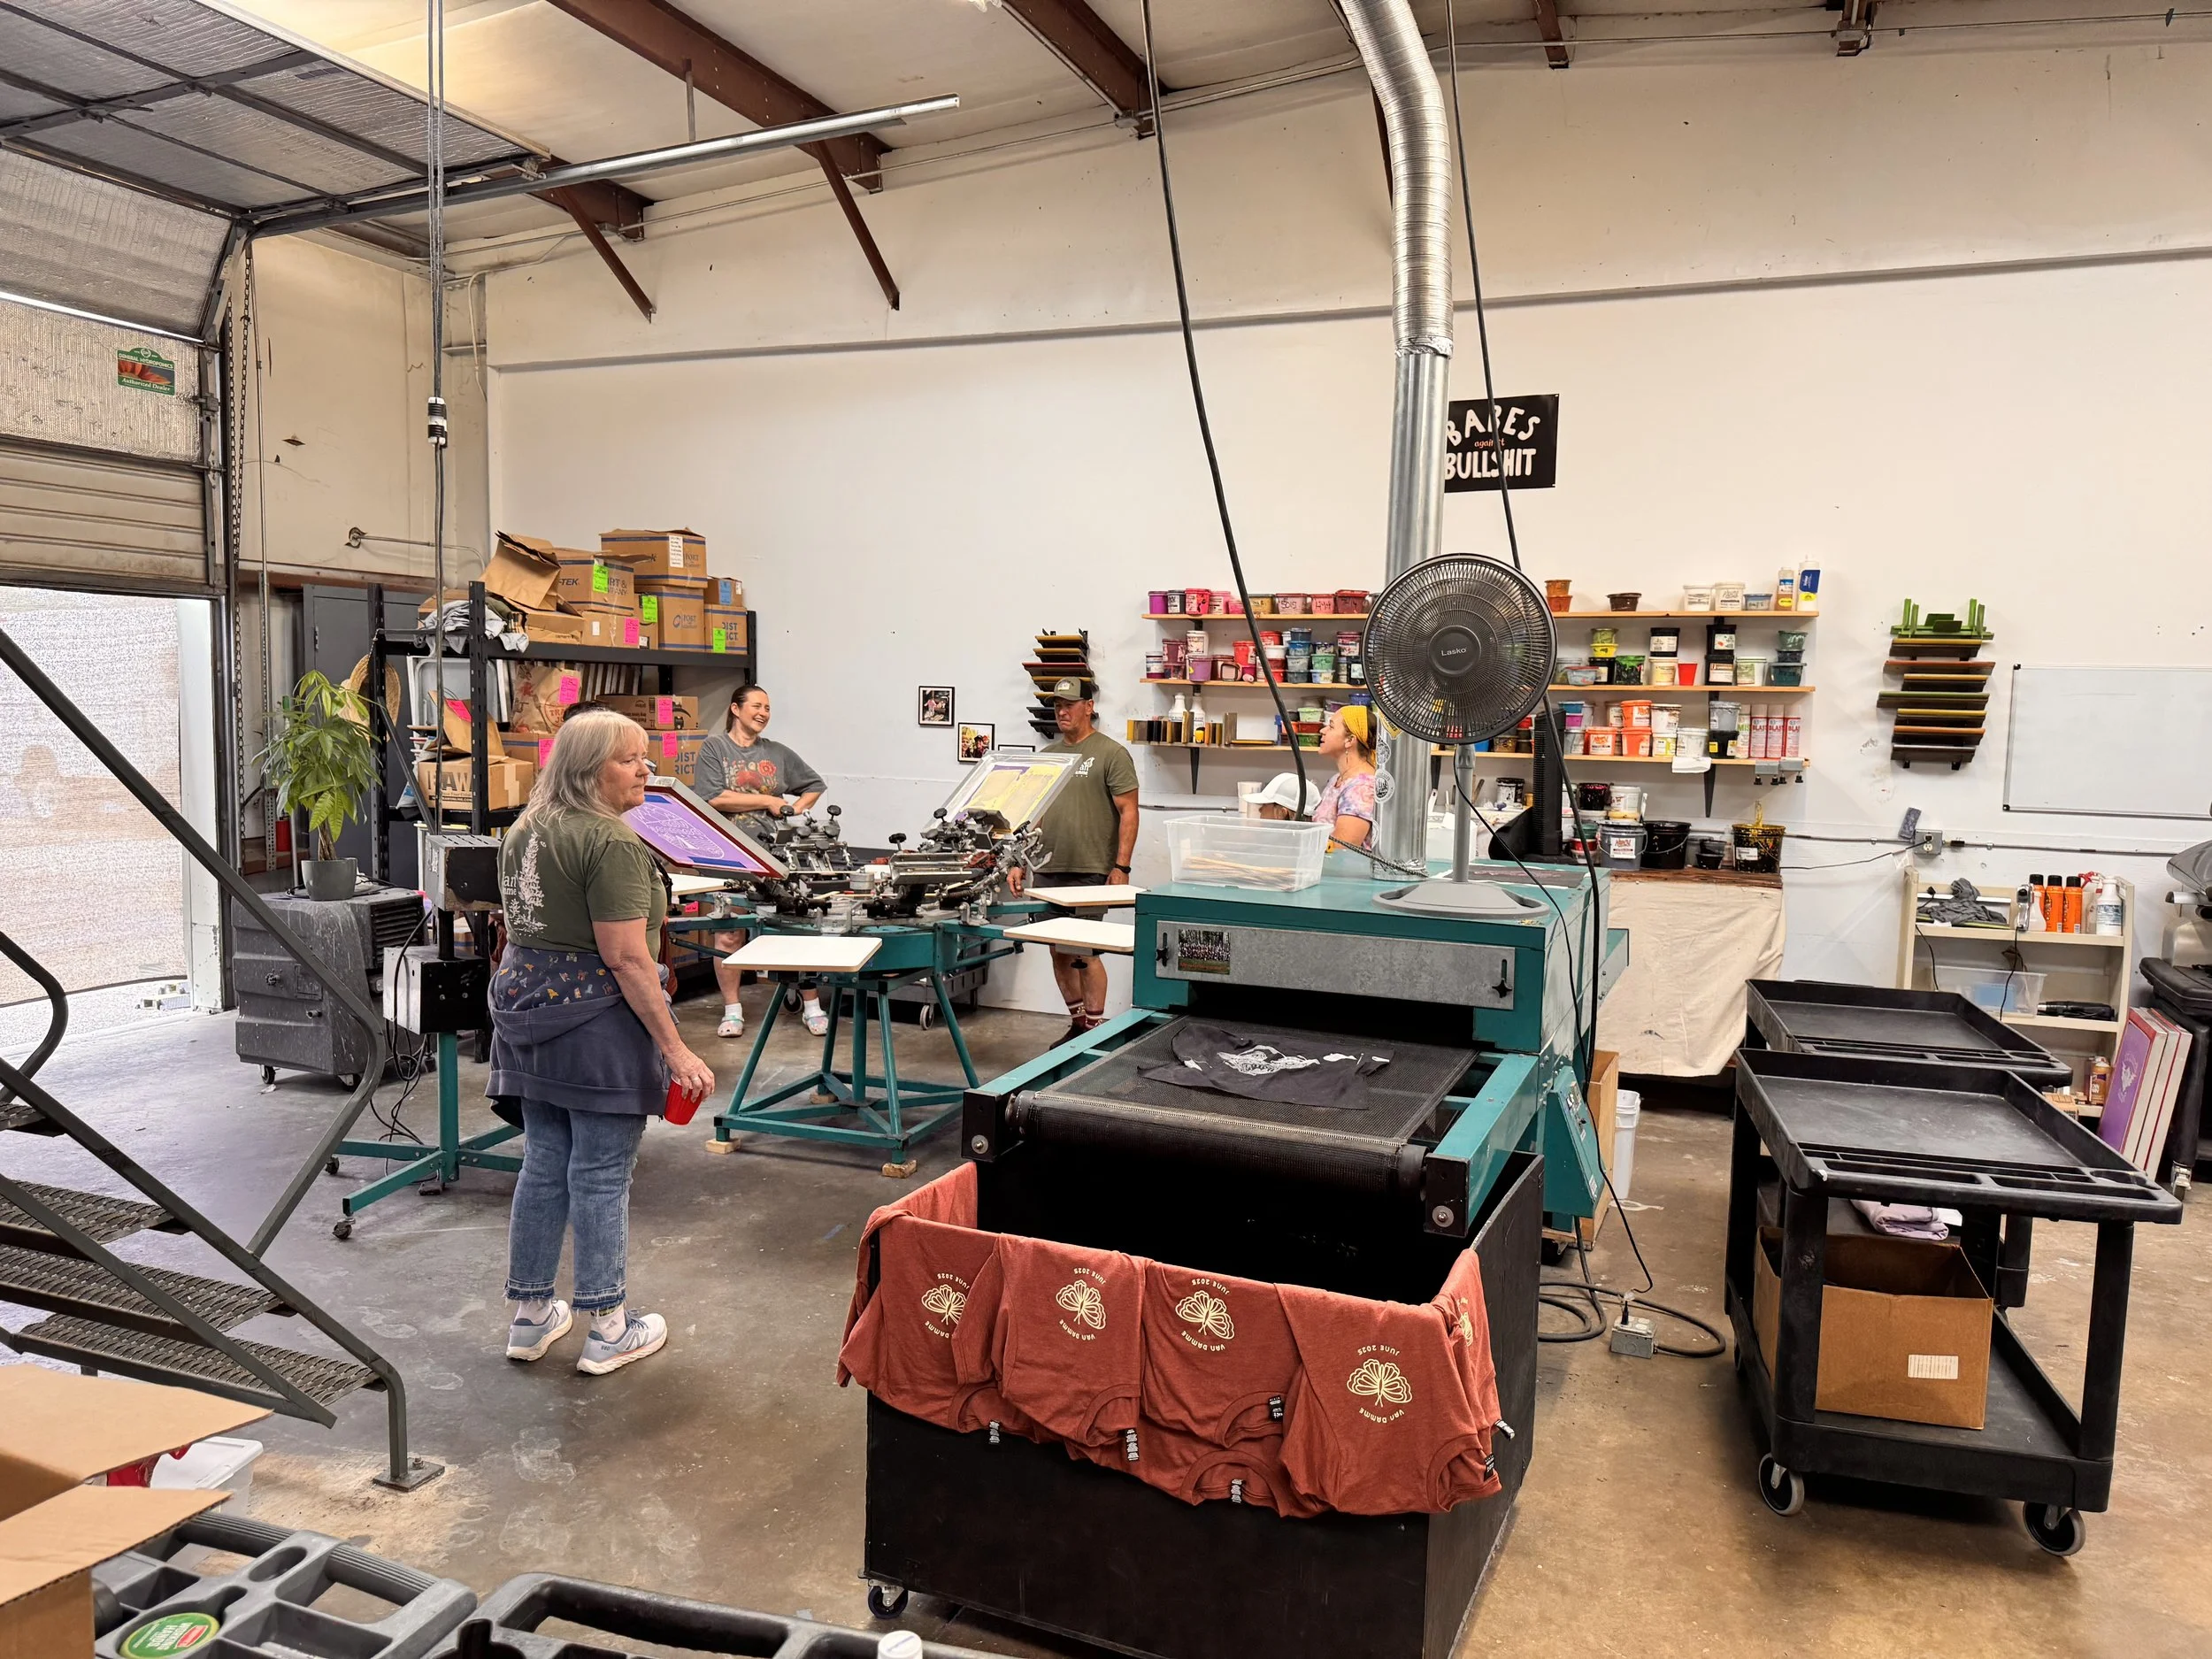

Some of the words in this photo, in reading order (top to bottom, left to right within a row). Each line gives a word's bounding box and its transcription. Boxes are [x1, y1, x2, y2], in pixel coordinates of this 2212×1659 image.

[1447, 405, 1540, 446] BABES
[1445, 449, 1537, 480] BULLSHIT
[1441, 647, 1467, 657] Lasko
[956, 1276, 970, 1289] JUNE
[1091, 1271, 1106, 1285] JUNE
[1212, 1280, 1230, 1294] JUNE
[925, 1320, 949, 1339] DAMME
[1059, 1319, 1079, 1340] DAMME
[1181, 1330, 1208, 1351] DAMME
[1210, 1343, 1225, 1352] VAN
[1357, 1344, 1377, 1356] 2025
[1380, 1344, 1400, 1356] JUNE
[1359, 1407, 1387, 1424] DAMME
[1389, 1409, 1405, 1421] VAN
